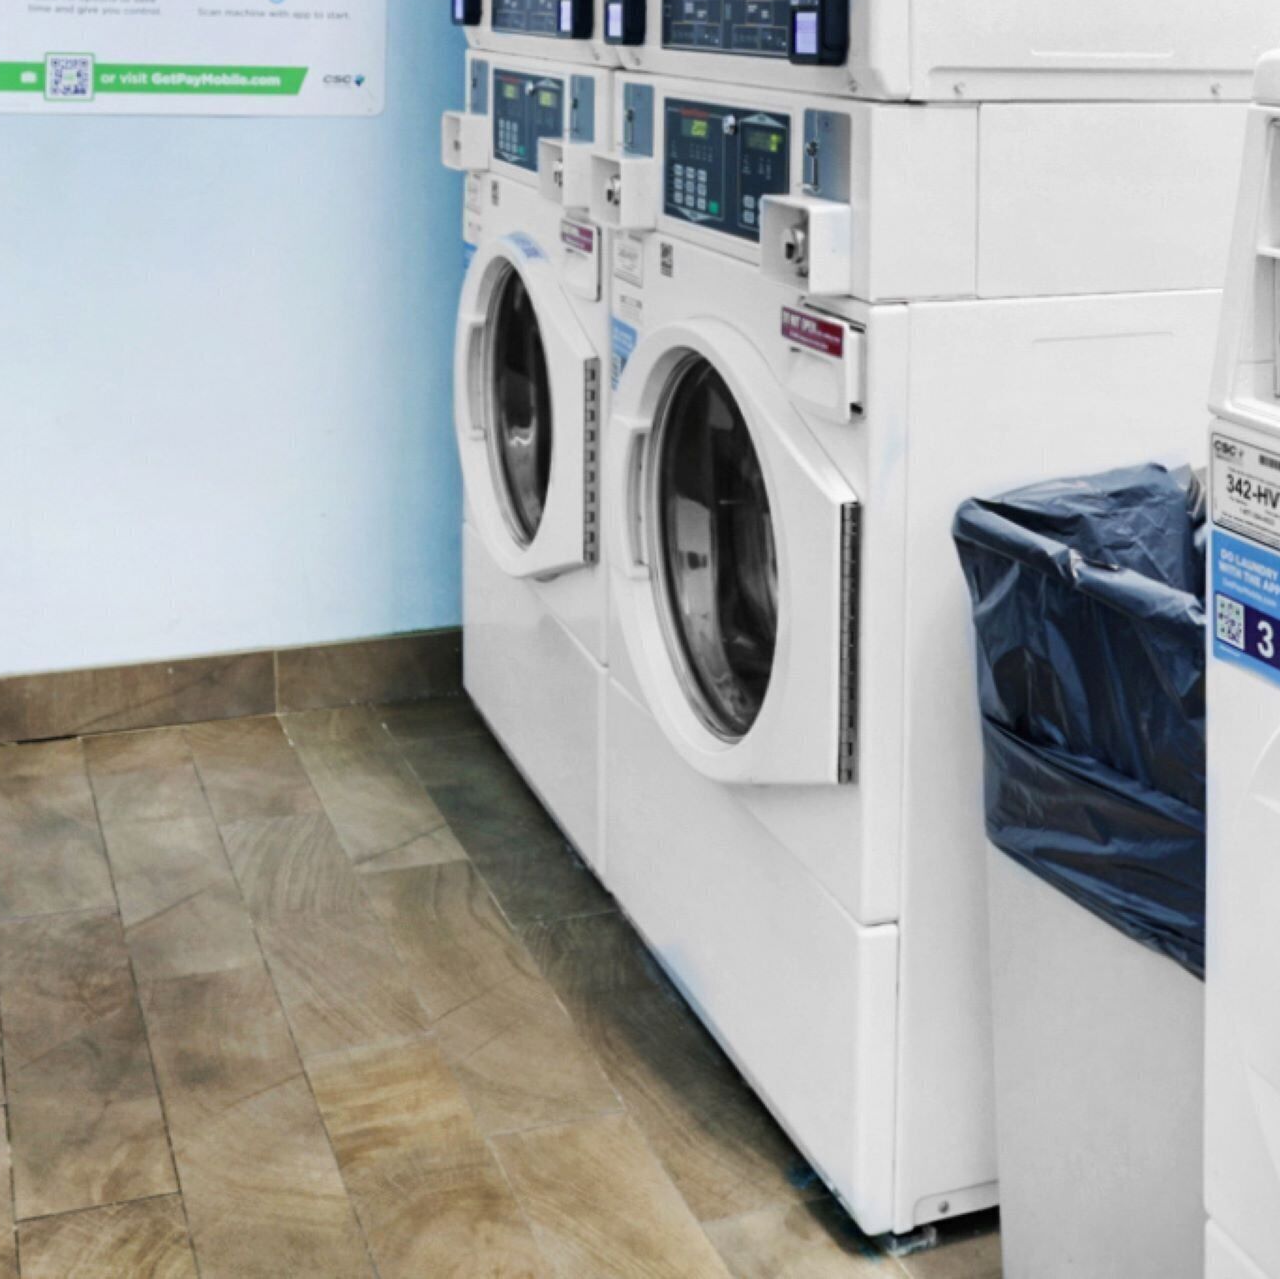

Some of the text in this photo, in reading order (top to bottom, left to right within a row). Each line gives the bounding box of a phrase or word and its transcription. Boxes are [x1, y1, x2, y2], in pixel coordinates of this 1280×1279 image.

[100, 71, 282, 88] or visit GetPayMobile.com
[1218, 560, 1243, 580] WITH
[1244, 569, 1261, 588] THE
[1220, 548, 1278, 580] DO LAUNDRY
[1257, 620, 1274, 659] 3
